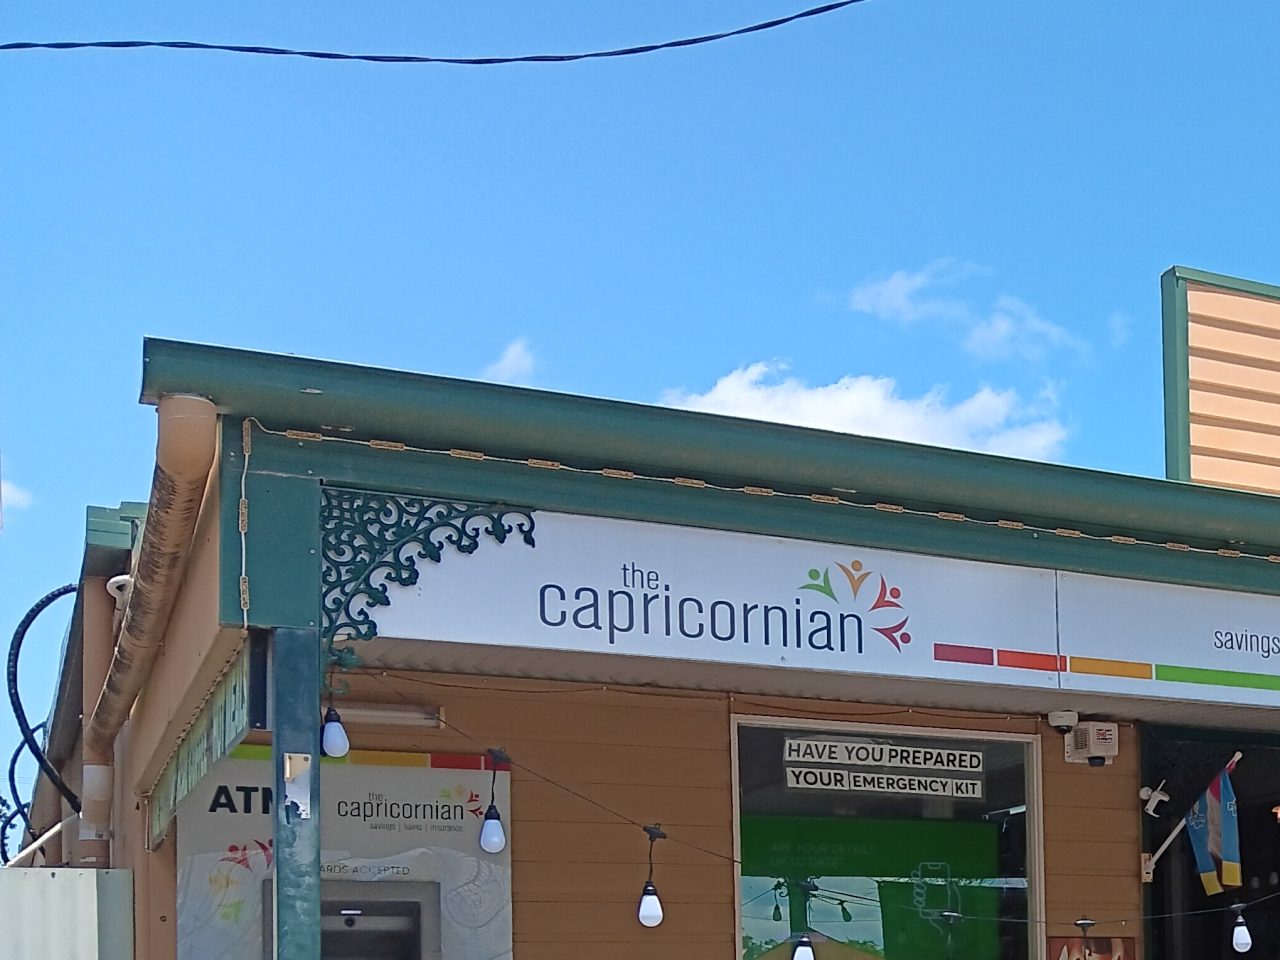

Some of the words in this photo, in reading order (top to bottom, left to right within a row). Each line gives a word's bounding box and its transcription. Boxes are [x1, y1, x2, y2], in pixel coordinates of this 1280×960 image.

[621, 562, 660, 590] the
[538, 583, 864, 654] capricornian
[1213, 629, 1280, 659] savings
[787, 742, 838, 760] HAVE
[844, 745, 884, 762] YOU
[888, 748, 981, 769] PREPARED
[790, 770, 845, 788] YOUR
[853, 775, 949, 793] EMERGENCY
[954, 782, 978, 795] KIT
[368, 791, 385, 802] the
[337, 798, 464, 823] capricornian
[319, 864, 349, 875] ARDS
[352, 865, 411, 876] ACCEPTED
